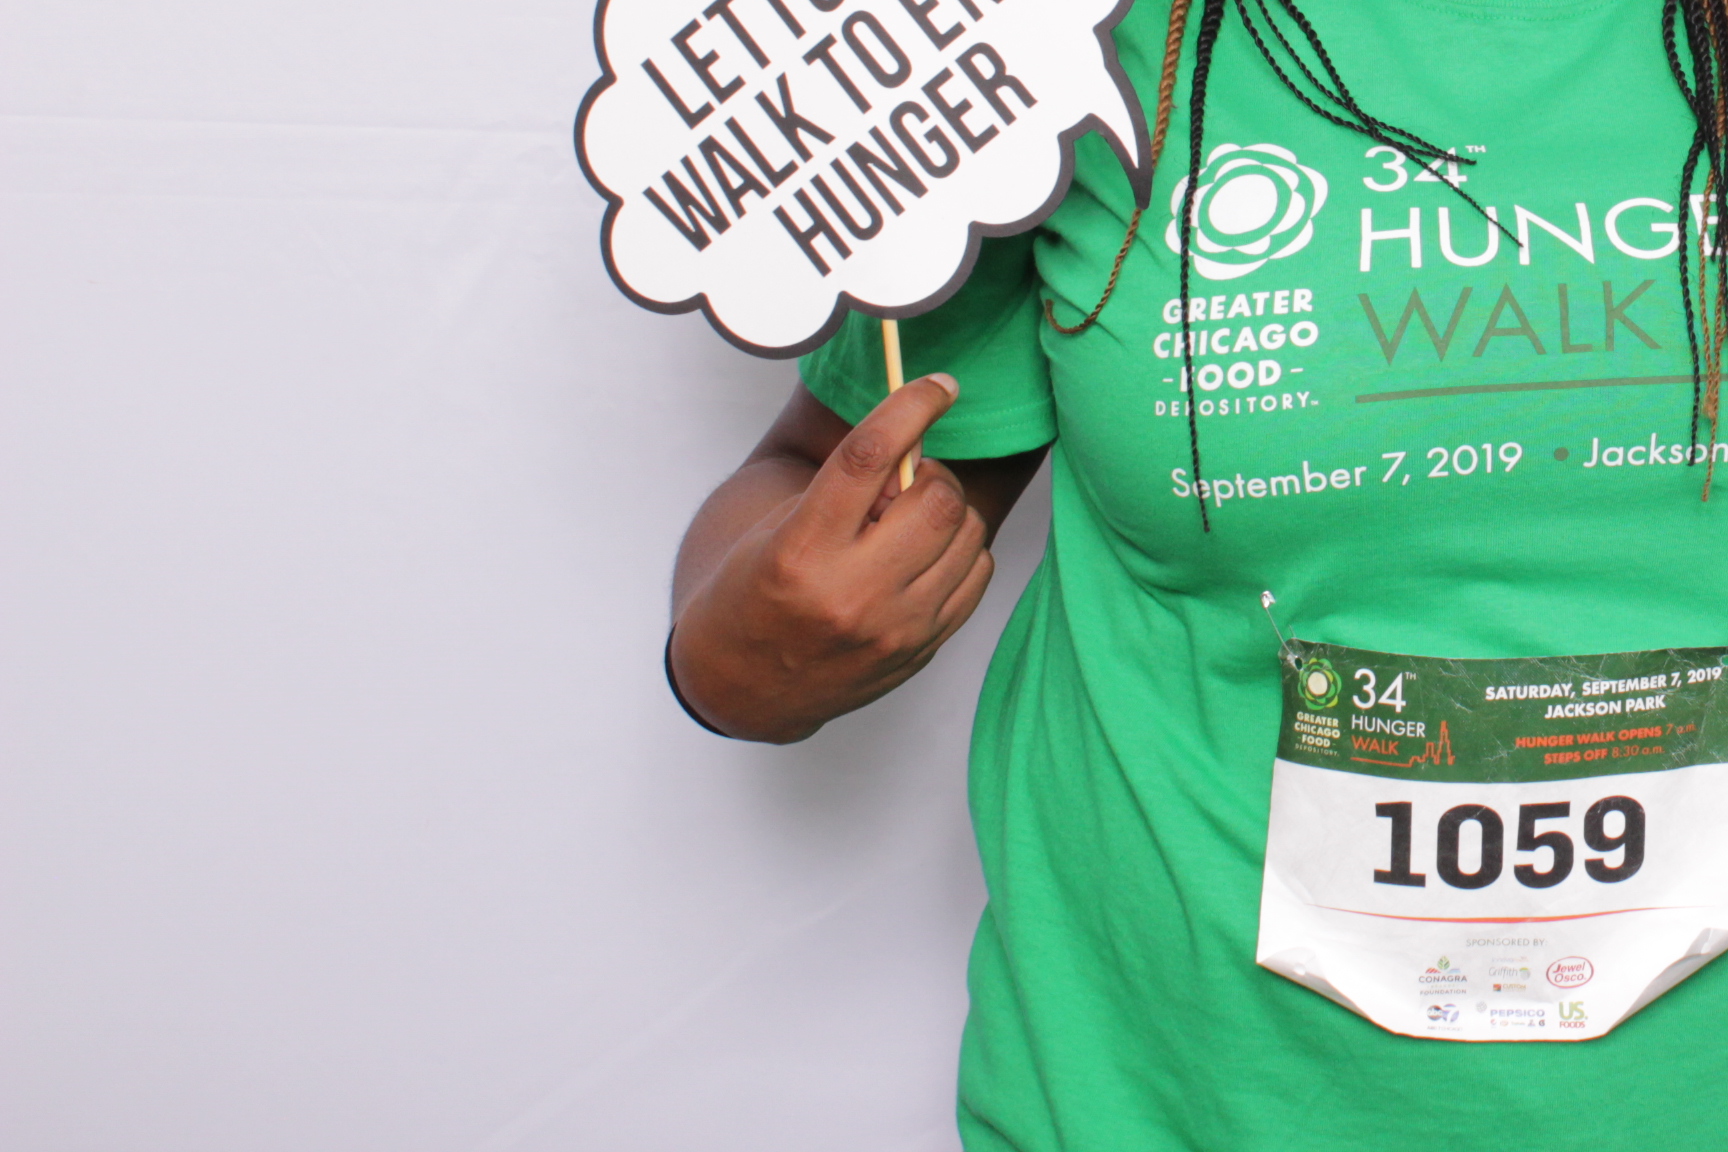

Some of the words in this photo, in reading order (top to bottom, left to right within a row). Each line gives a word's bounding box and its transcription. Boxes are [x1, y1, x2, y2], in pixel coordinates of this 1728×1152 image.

[641, 71, 836, 252] WALK
[801, 9, 912, 115] TO
[772, 41, 1038, 278] HUNGER
[1162, 288, 1313, 324] GREATER
[1357, 279, 1662, 367] WALK
[1153, 320, 1319, 359] CHICAGO
[1171, 460, 1367, 507] September
[1381, 451, 1411, 486] 7,
[1427, 441, 1523, 479] 2019
[1485, 683, 1575, 701] SATURDAY,
[1581, 674, 1667, 697] SEPTEMBER
[1670, 672, 1682, 689] 7,
[1687, 666, 1722, 685] 2019
[1296, 711, 1339, 728] GREATER
[1544, 700, 1622, 720] JACKSON
[1625, 695, 1666, 712] PARK
[1294, 721, 1341, 739] CHICAGO
[1351, 714, 1426, 738] HUNGER
[1515, 734, 1574, 748] HUNGER
[1577, 731, 1616, 744] WALK
[1618, 725, 1663, 742] OPENS
[1665, 723, 1674, 736] 7
[1351, 735, 1399, 755] WALK
[1544, 751, 1581, 765] STEPS
[1583, 748, 1609, 762] OFF
[1611, 745, 1640, 758] 8:30
[1373, 795, 1646, 890] 1059
[1466, 938, 1530, 947] SPONSORED
[1418, 975, 1468, 984] CONAGRA
[1553, 962, 1586, 974] Jewel
[1490, 1009, 1545, 1017] PEPSICO
[1559, 1021, 1586, 1029] FOODS
